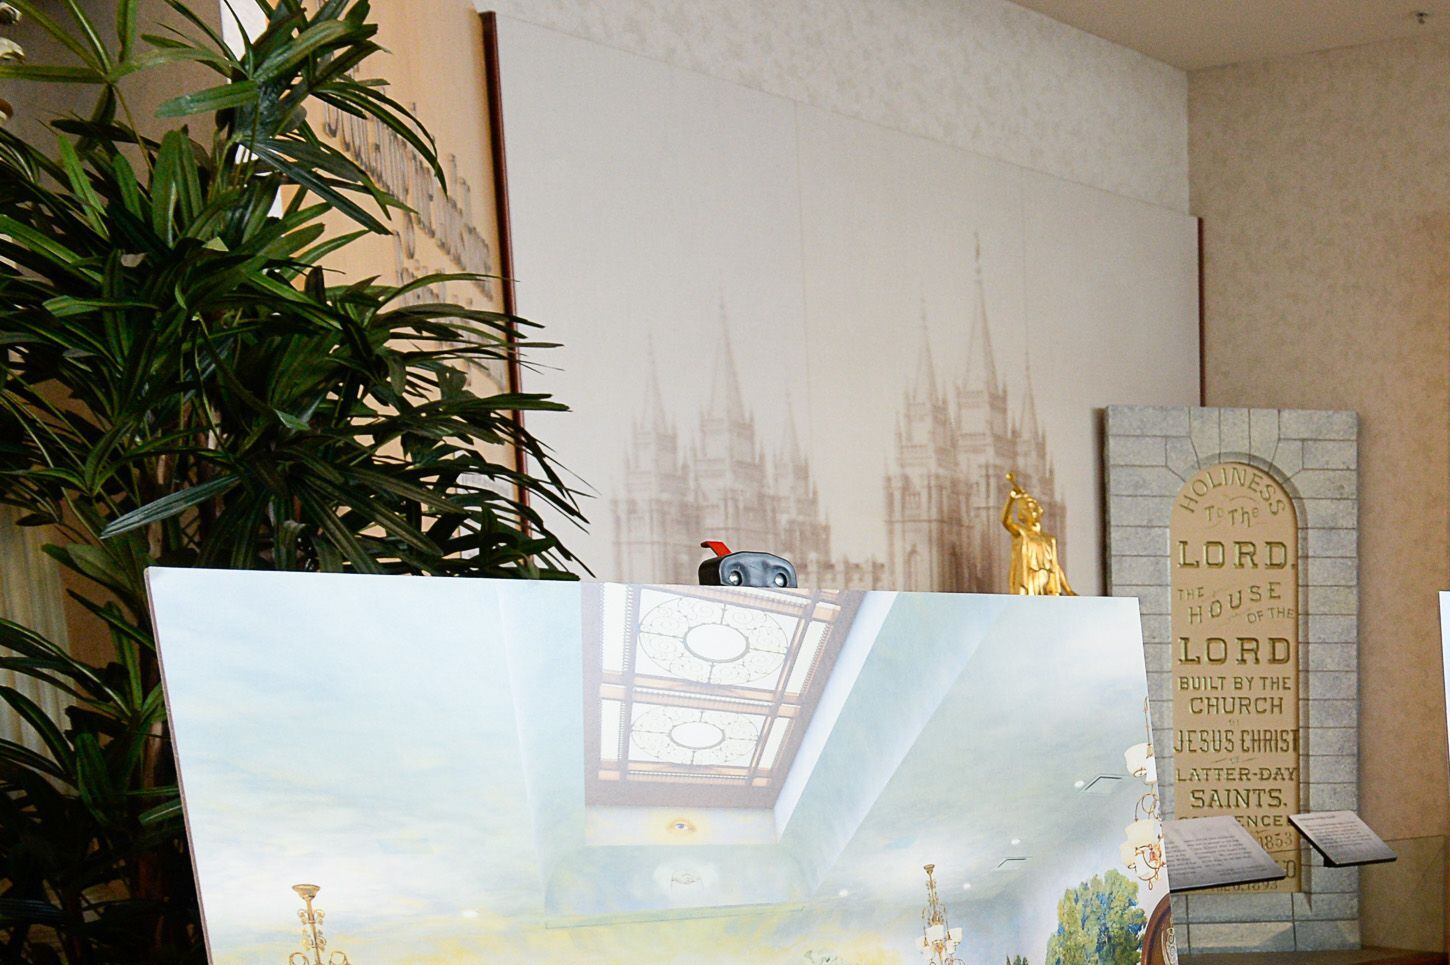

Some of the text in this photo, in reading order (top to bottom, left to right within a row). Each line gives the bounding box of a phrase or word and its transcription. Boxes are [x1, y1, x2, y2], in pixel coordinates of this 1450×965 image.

[1179, 467, 1286, 515] HOLINESS
[1227, 506, 1259, 528] The
[1178, 540, 1296, 569] LORD.
[1177, 586, 1204, 600] THE
[1188, 581, 1282, 624] HOUSE
[1246, 607, 1296, 624] OF THE
[1178, 636, 1291, 665] LORD
[1178, 676, 1292, 691] BUILT BY THE
[1190, 696, 1284, 715] CHURCH
[1174, 729, 1299, 753] JESUS CHRIST
[1176, 767, 1298, 782] LATTER-DAY
[1190, 788, 1289, 808] SAINTS.
